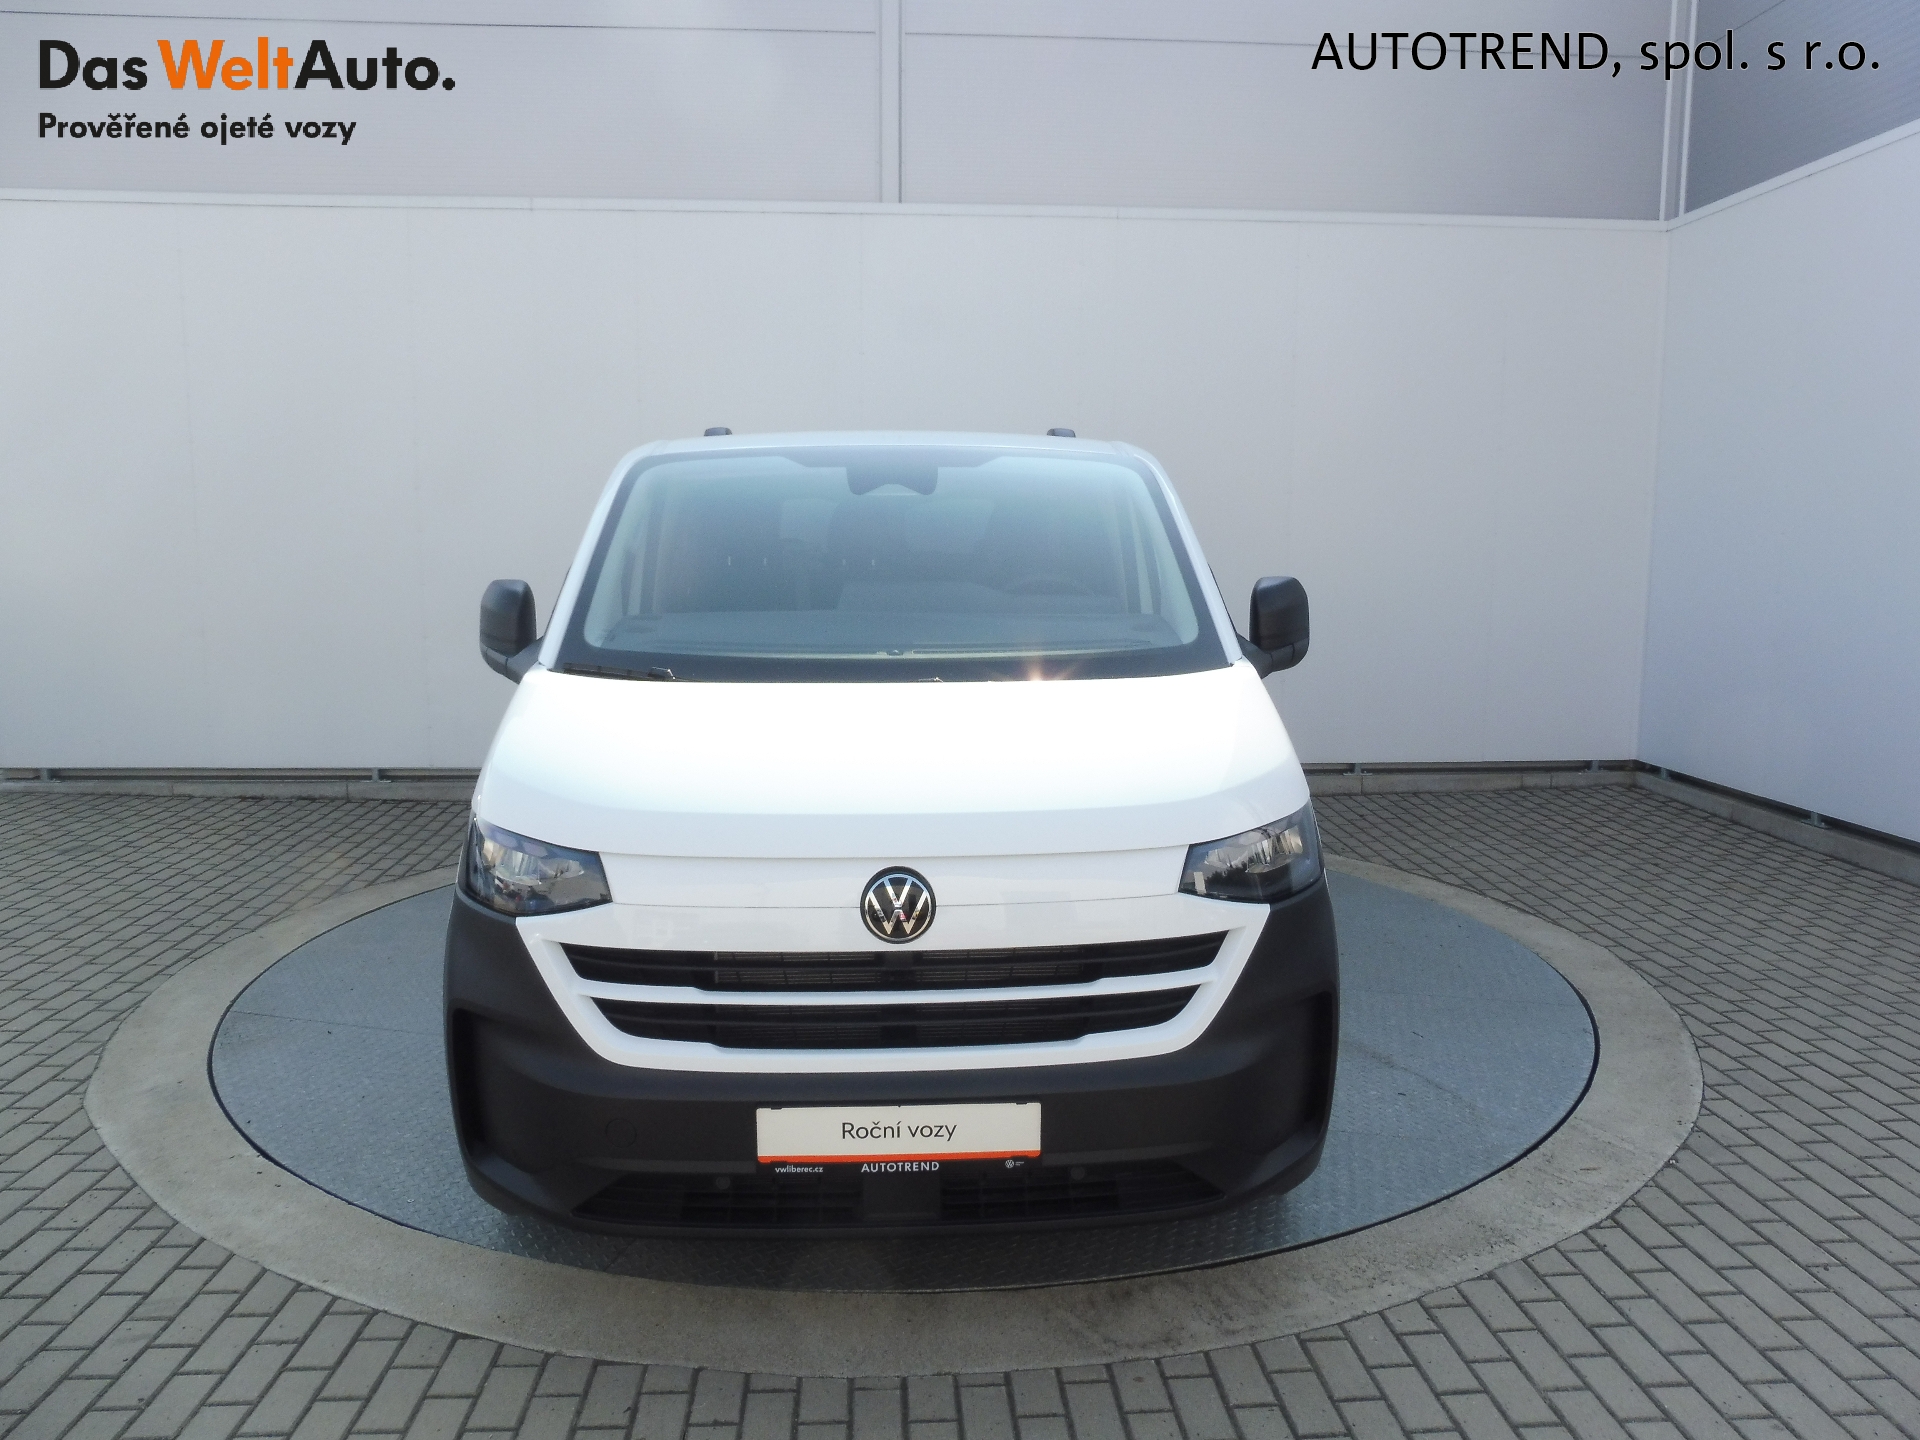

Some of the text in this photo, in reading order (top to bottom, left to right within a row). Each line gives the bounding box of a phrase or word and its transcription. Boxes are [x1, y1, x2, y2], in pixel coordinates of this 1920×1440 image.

[841, 1121, 957, 1142] Roční vozy
[774, 1165, 824, 1173] vwliberec.cz
[861, 1161, 940, 1173] AUTOTREND
